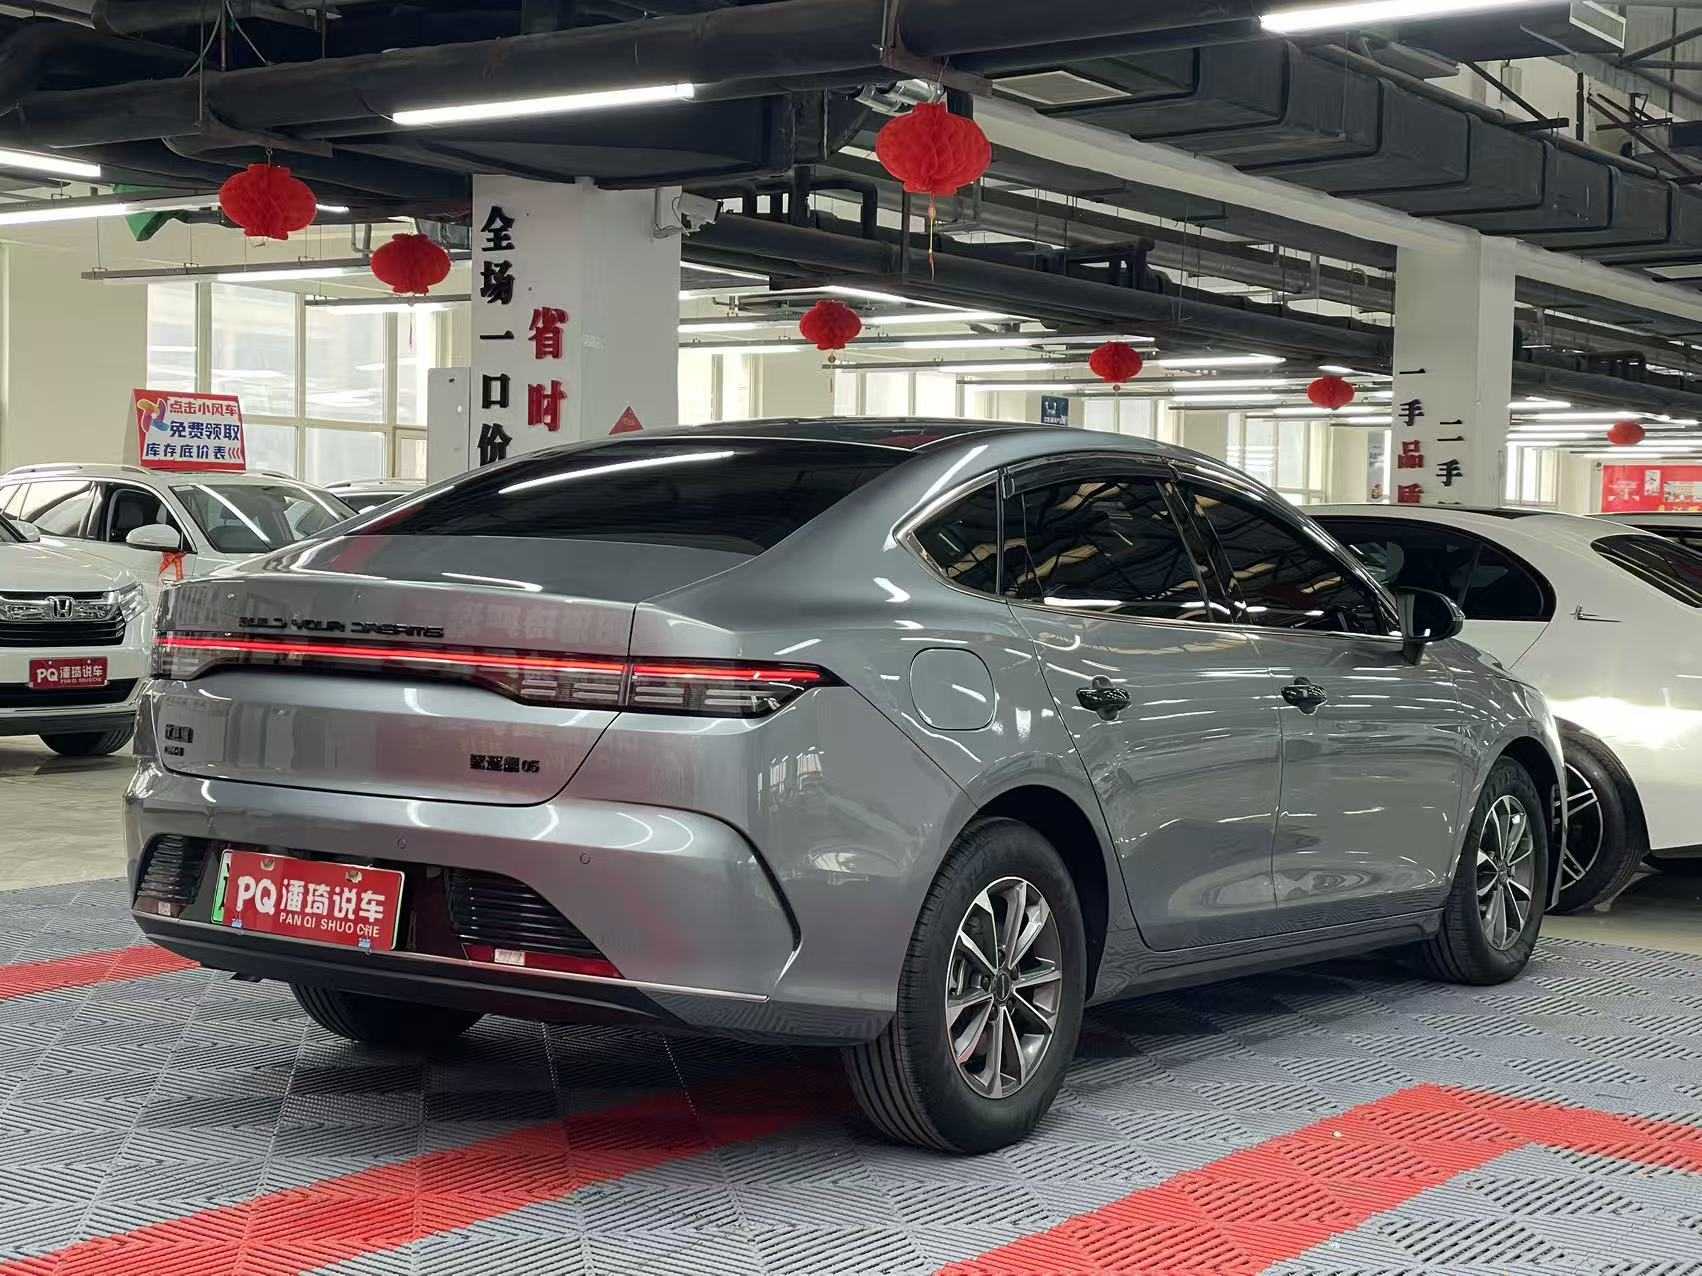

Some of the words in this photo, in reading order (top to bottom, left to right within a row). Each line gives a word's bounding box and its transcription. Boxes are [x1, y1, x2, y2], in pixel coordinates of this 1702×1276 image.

[478, 206, 515, 466] 全场一口价
[527, 307, 568, 432] 省时
[169, 400, 238, 417] 点击小风车
[169, 420, 241, 441] 免费领取
[145, 442, 226, 460] 库存底价表
[36, 668, 58, 683] PQ
[235, 875, 278, 915] PQ
[279, 878, 386, 923] 潘琦说车
[279, 912, 302, 927] PAN
[303, 915, 316, 929] QI
[320, 918, 354, 934] SHUO
[356, 922, 380, 938] CHE
